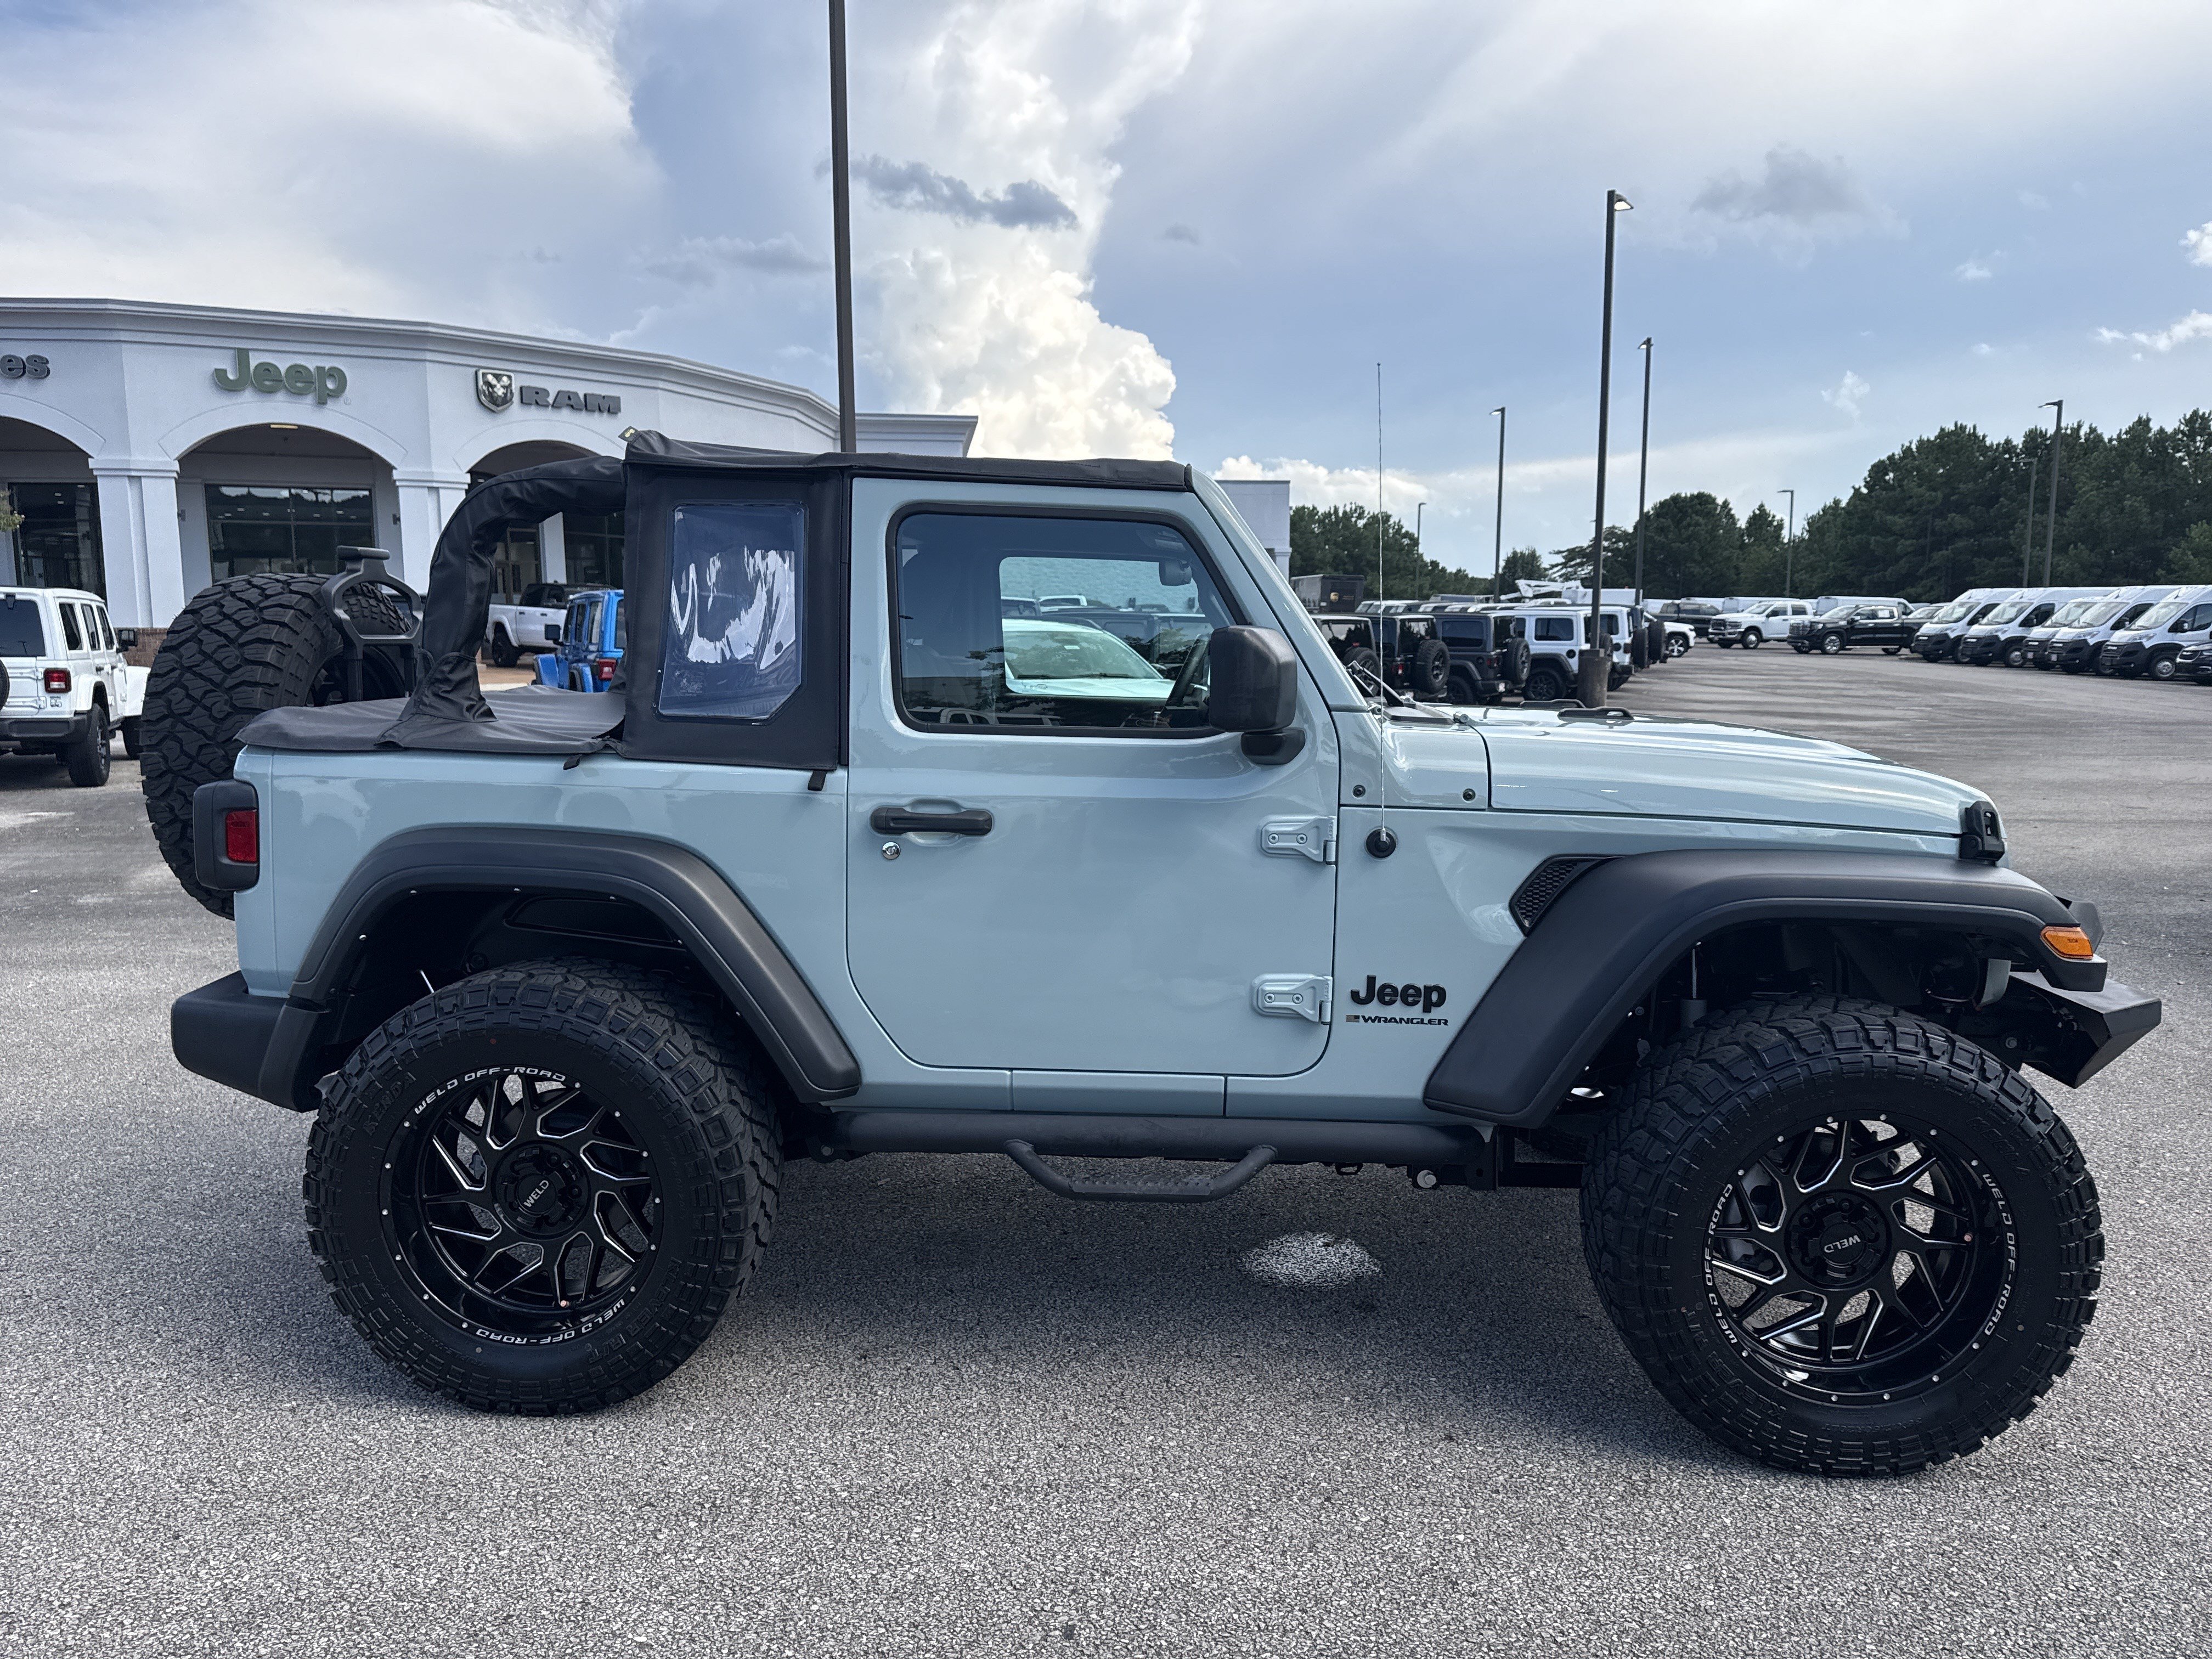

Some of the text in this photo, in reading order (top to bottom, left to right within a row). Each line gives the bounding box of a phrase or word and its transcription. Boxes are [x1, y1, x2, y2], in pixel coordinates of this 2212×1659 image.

[214, 348, 348, 405] Jeep
[520, 385, 622, 414] RAM
[1351, 974, 1447, 1013] Jeep
[1361, 1015, 1449, 1026] WRANGLER
[414, 1066, 567, 1115] WELD OFF-ROAD
[523, 1180, 549, 1207] WELD
[1703, 1183, 1733, 1286] OFF-ROAD
[1824, 1234, 1861, 1253] WELD
[1982, 1173, 2017, 1336] WELD OFF-ROAD
[476, 1298, 625, 1345] WELD OFF-ROAD
[1708, 1293, 1738, 1345] WELD
